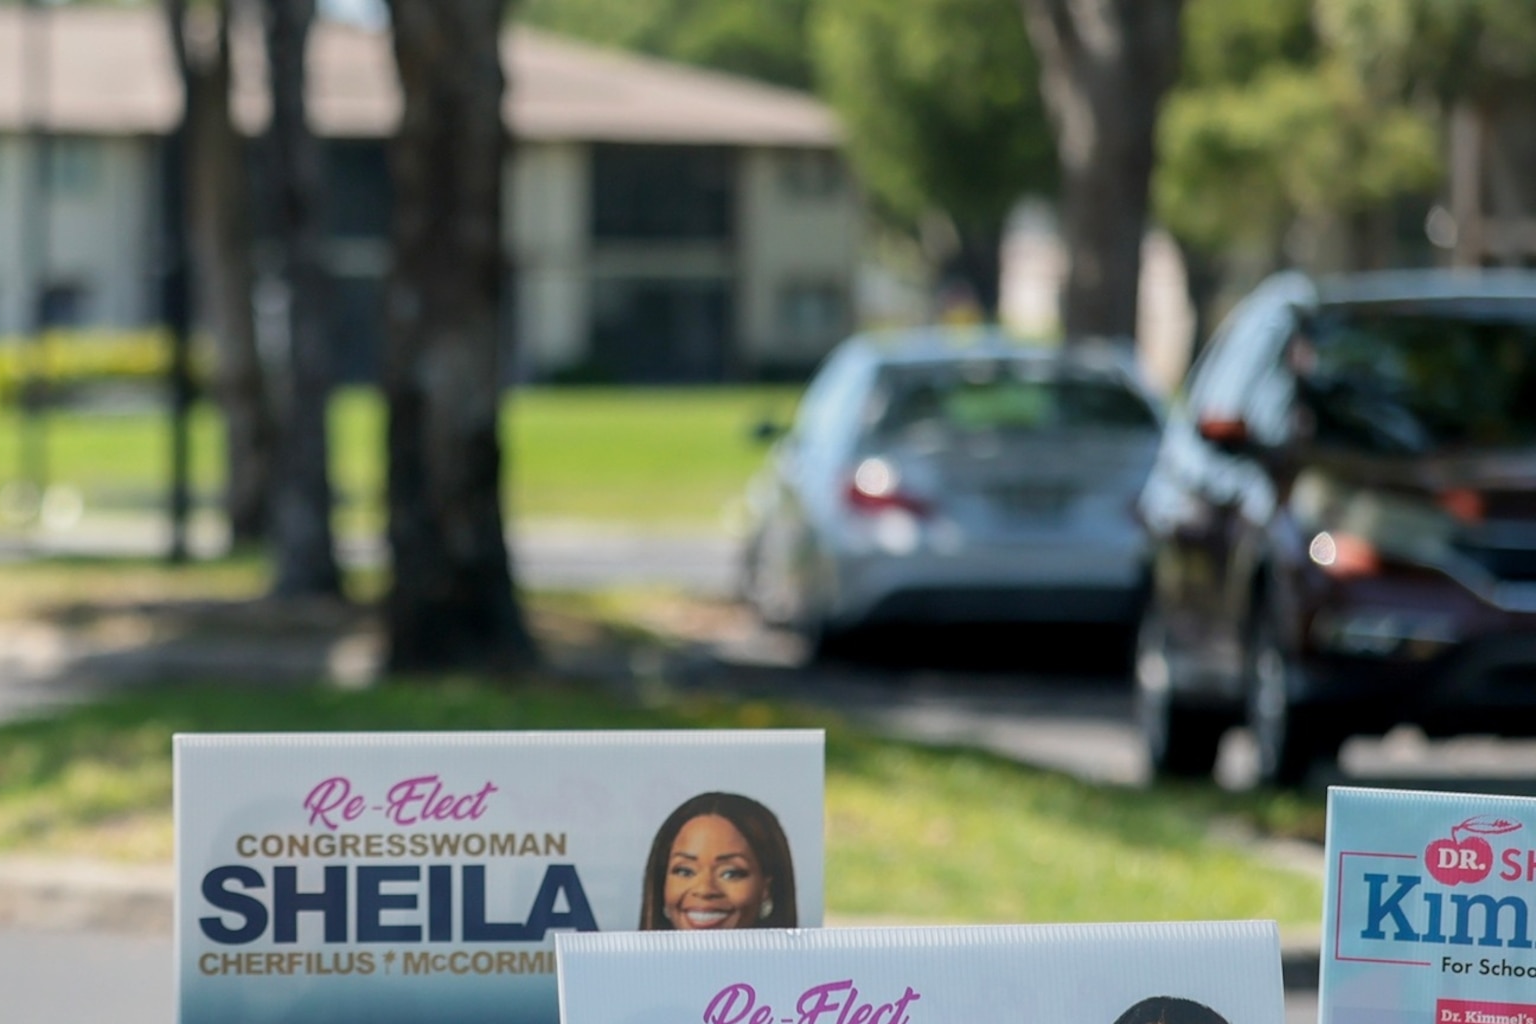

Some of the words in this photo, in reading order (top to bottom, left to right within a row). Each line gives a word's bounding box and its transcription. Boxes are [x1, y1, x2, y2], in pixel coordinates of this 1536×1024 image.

[303, 774, 498, 830] Re-Elect
[236, 833, 566, 858] CONGRESSWOMAN
[1437, 847, 1486, 870] DR.
[199, 863, 600, 945] SHEILA
[1361, 873, 1536, 949] Kim
[199, 952, 375, 976] CHERFILUS
[404, 951, 555, 975] McCORMI
[1442, 956, 1473, 974] For
[1479, 958, 1536, 978] Schoo
[1441, 1009, 1462, 1022] Dr.
